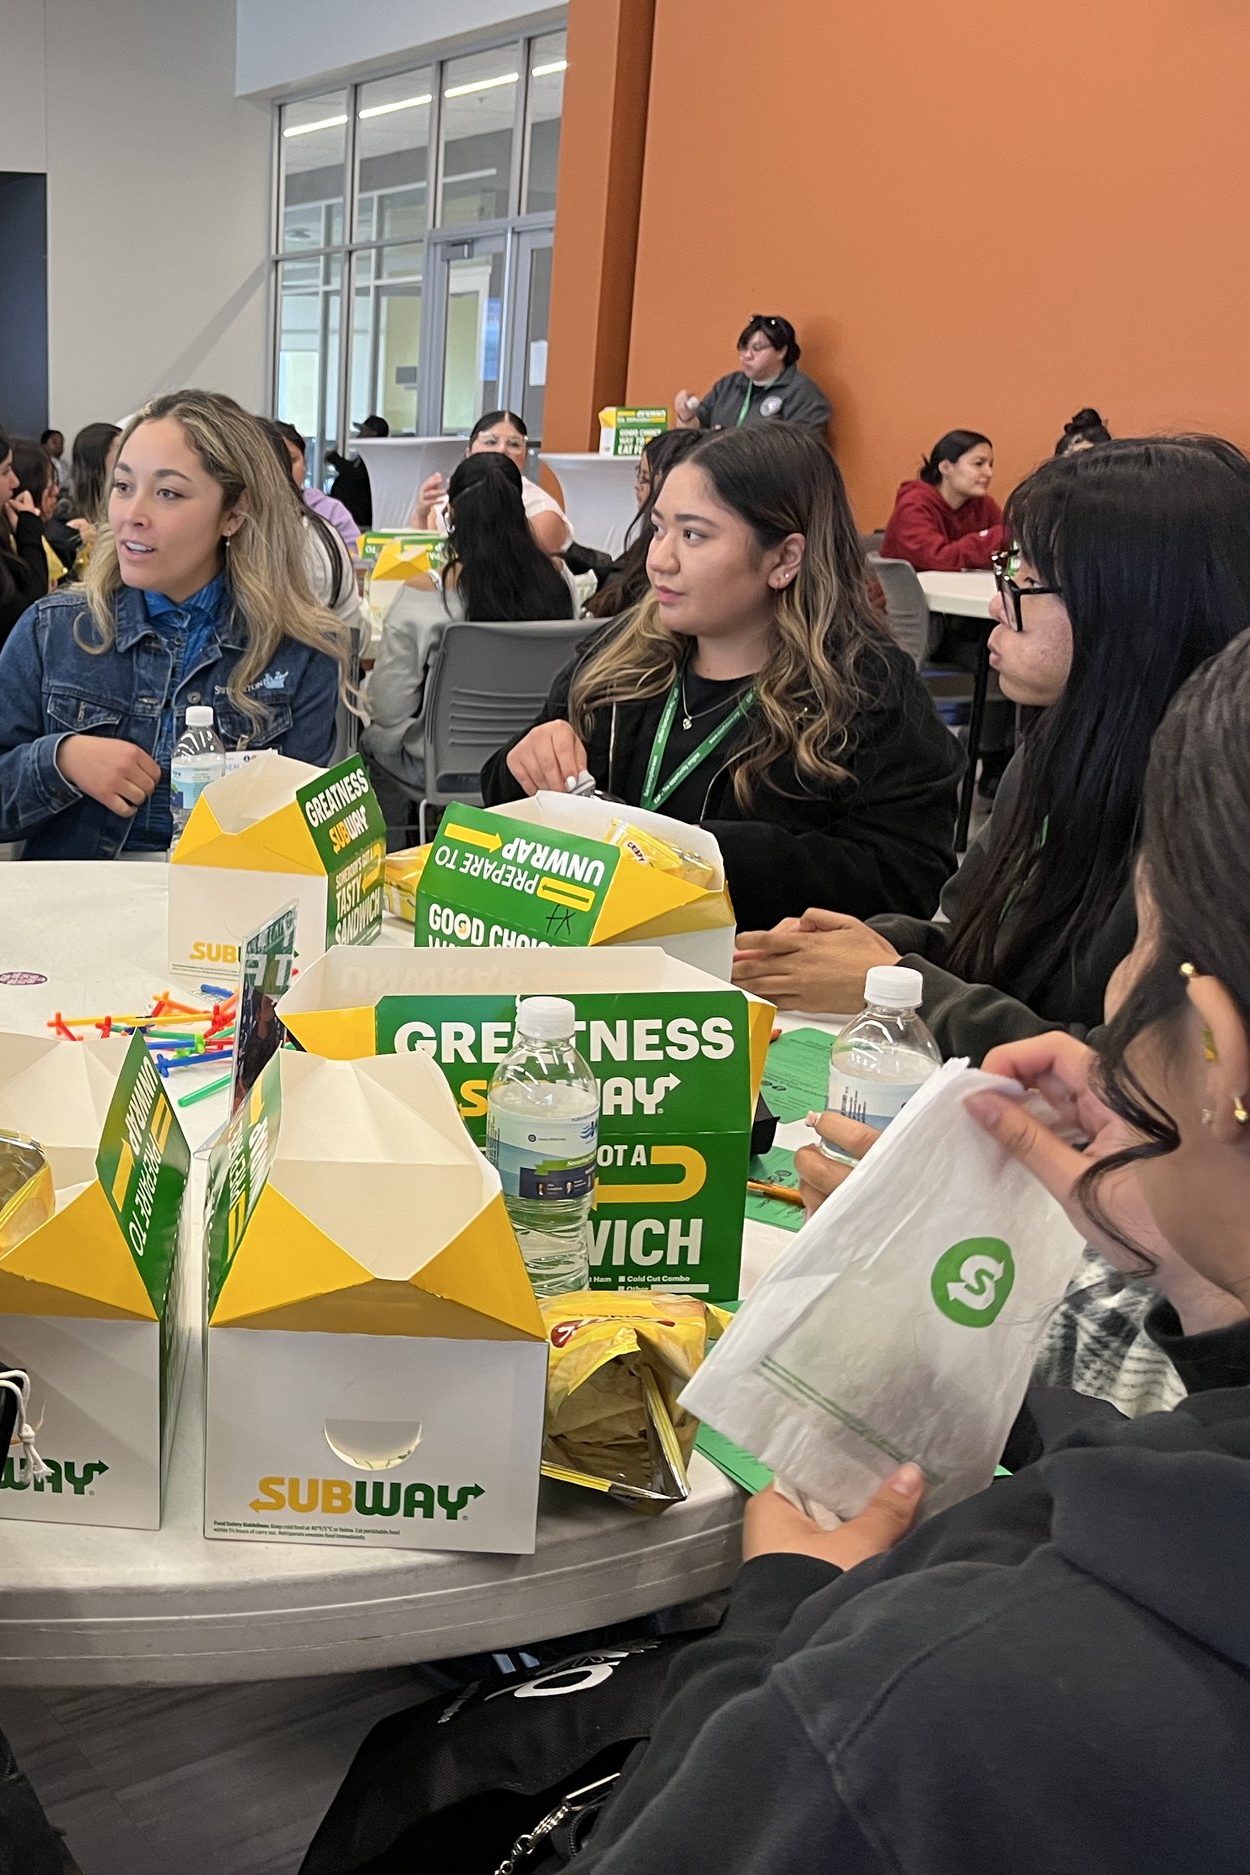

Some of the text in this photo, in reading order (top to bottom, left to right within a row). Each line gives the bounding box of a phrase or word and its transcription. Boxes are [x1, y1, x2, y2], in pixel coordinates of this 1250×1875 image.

[305, 768, 369, 828] GREATNESS
[328, 805, 369, 854] SUBWAY
[626, 841, 647, 863] CRISPY
[434, 845, 541, 895] PREPARE TO
[501, 837, 605, 886] UNWRAP
[335, 874, 362, 921] TASTY
[335, 886, 381, 946] SANDWICH
[428, 902, 485, 946] GOOD
[189, 941, 241, 964] SUB
[394, 1017, 735, 1064] GRETNESS
[125, 1056, 159, 1156] UNWRAP
[596, 1145, 627, 1167] OT
[631, 1145, 647, 1167] A
[129, 1133, 162, 1257] PREPARE TO
[626, 1275, 646, 1283] Cold
[646, 1275, 661, 1283] Cut
[662, 1275, 690, 1283] Combo
[248, 1475, 486, 1522] SUBWAY
